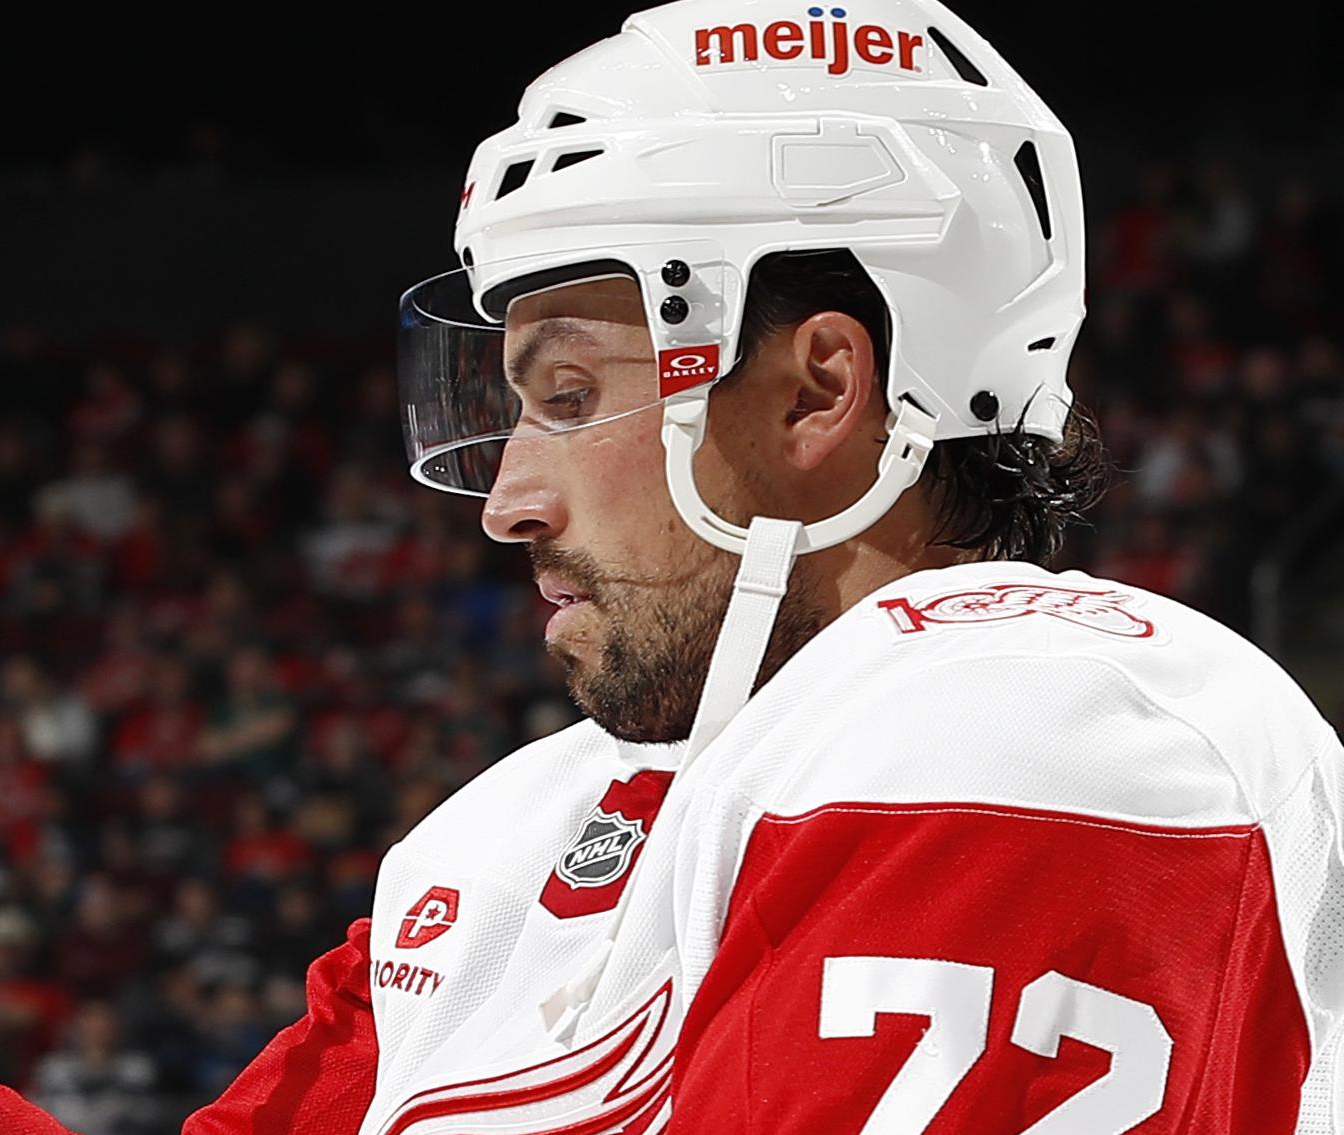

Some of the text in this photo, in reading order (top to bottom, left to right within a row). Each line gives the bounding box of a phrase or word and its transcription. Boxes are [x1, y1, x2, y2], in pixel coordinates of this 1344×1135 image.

[695, 6, 924, 75] meijer
[662, 365, 716, 379] OAKLEY
[568, 833, 624, 868] NHL
[371, 959, 446, 998] IORITY
